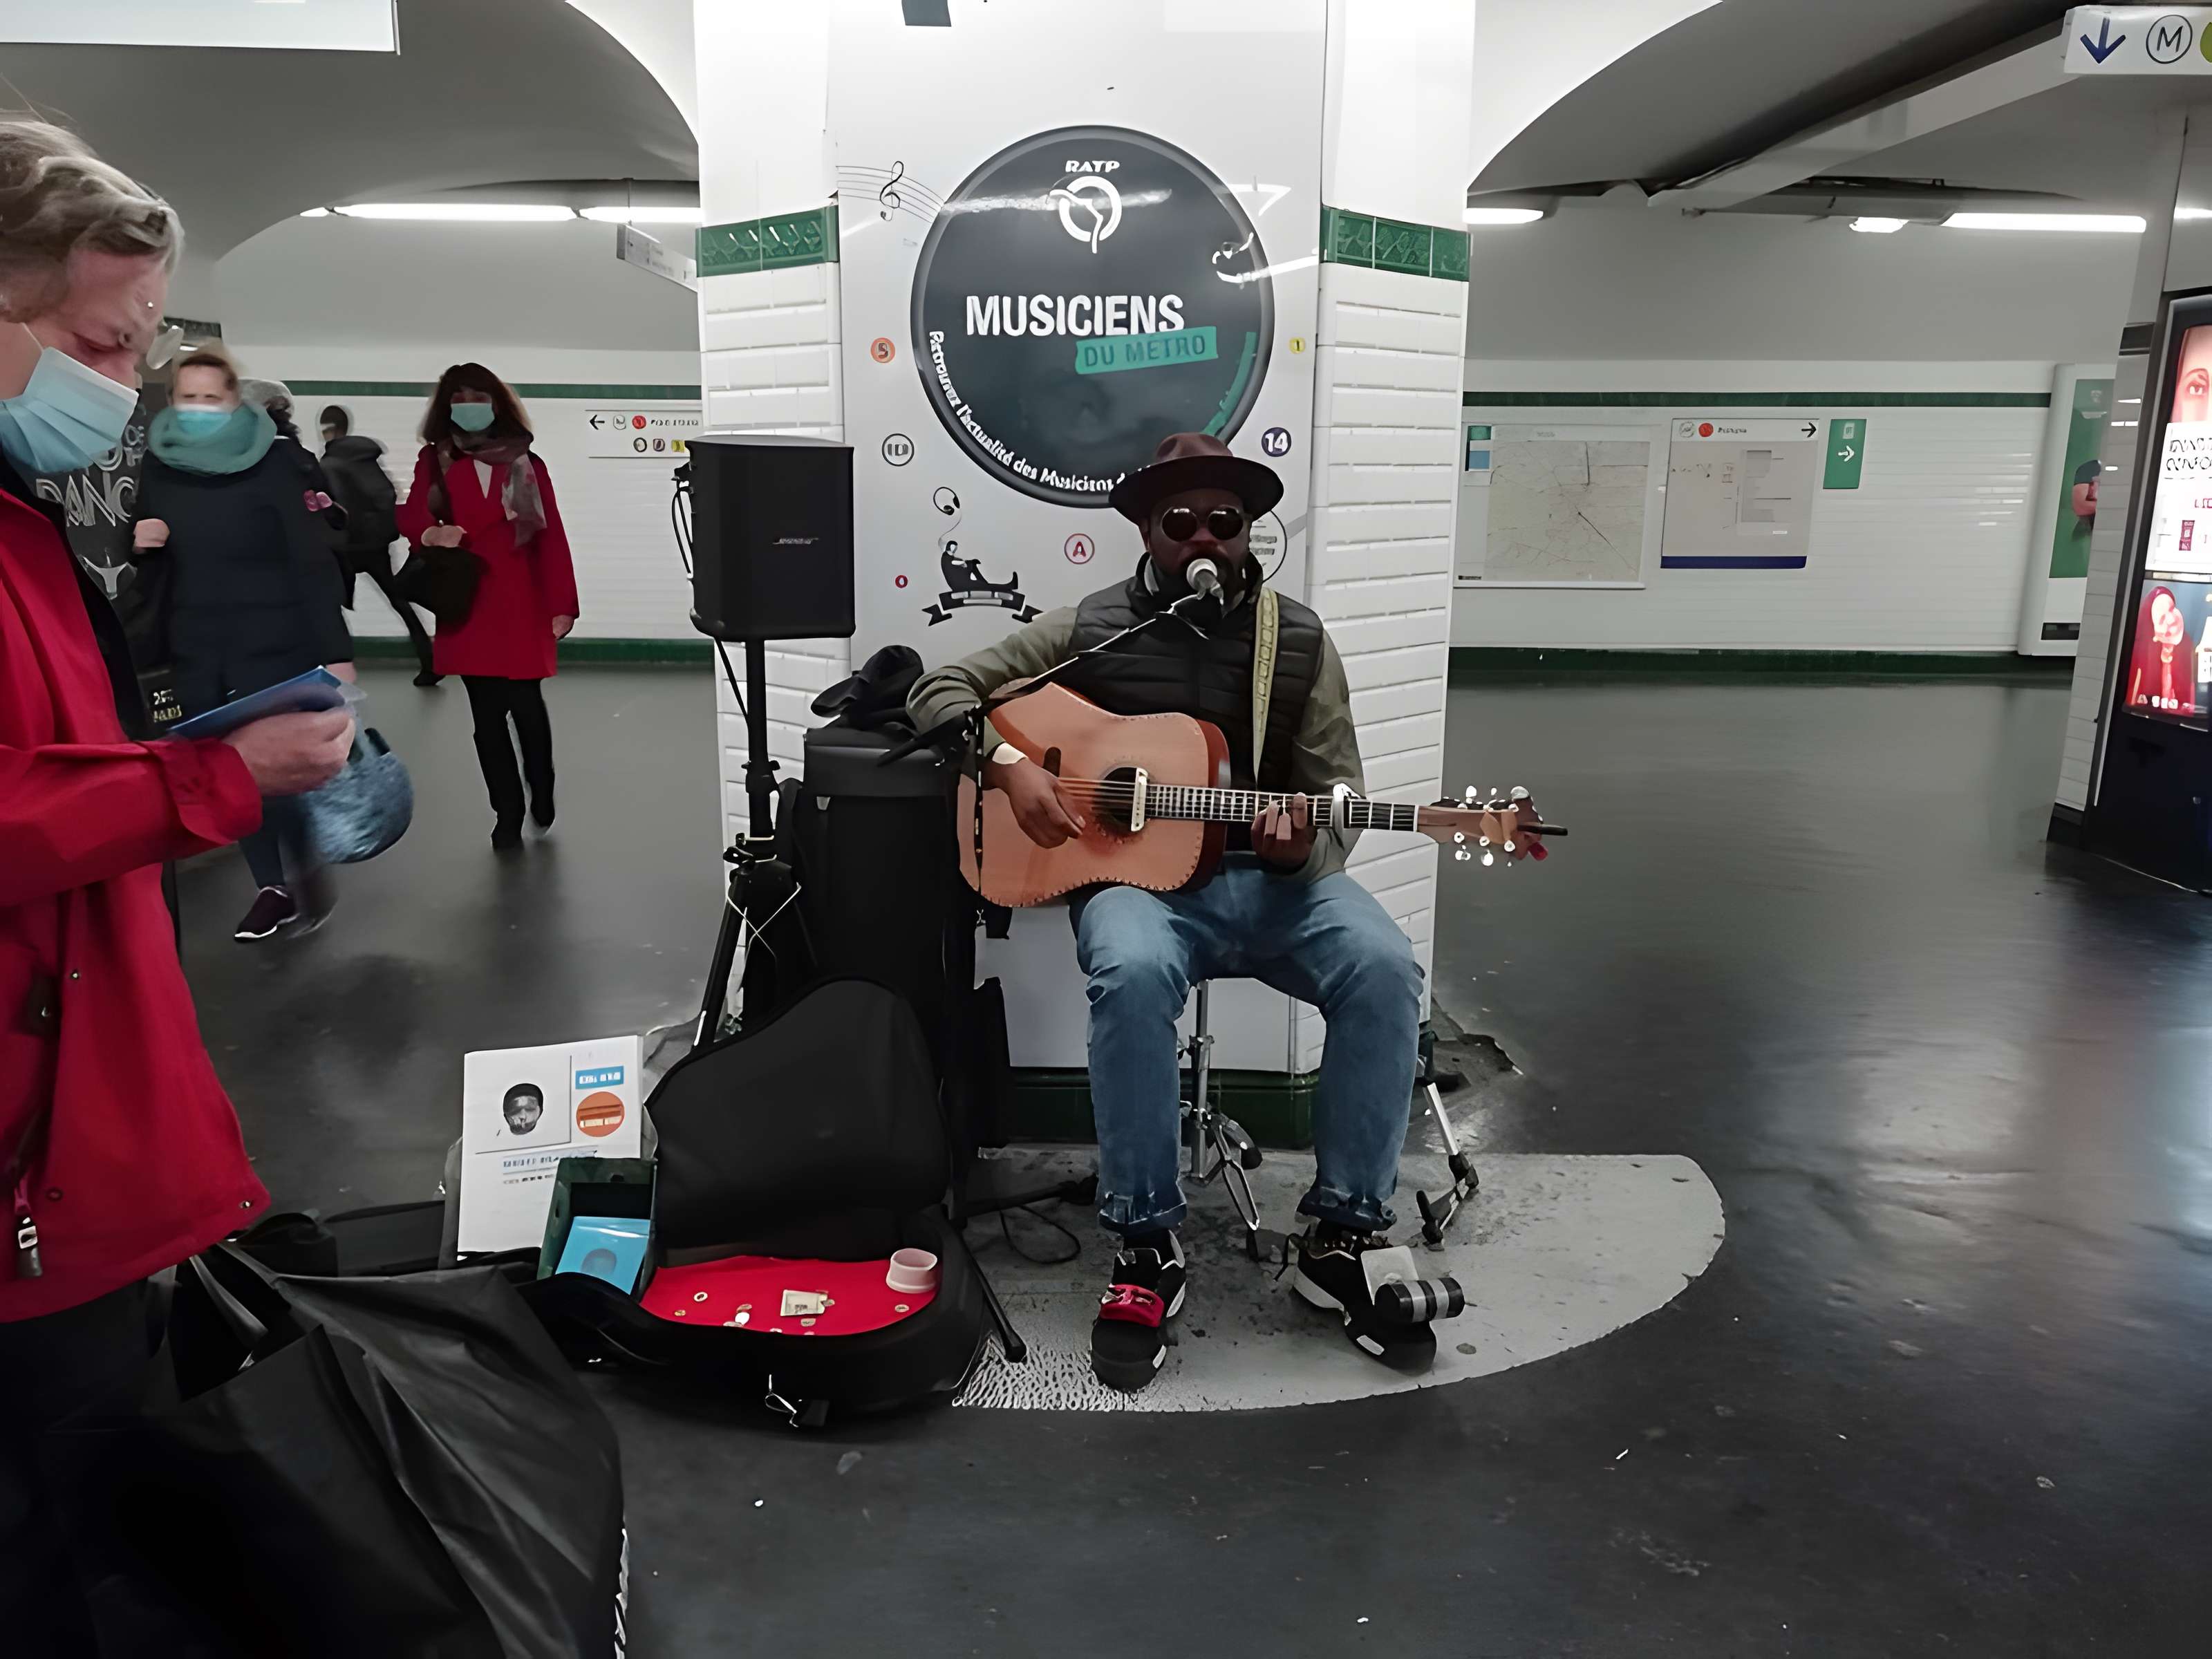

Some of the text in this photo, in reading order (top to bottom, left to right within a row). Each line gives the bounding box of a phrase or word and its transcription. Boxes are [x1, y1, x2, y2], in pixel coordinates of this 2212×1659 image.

[1065, 160, 1120, 173] RATP
[966, 294, 1185, 337] MUSICIENS
[1084, 344, 1115, 367] DU
[1264, 432, 1288, 453] 14
[1072, 541, 1087, 557] A
